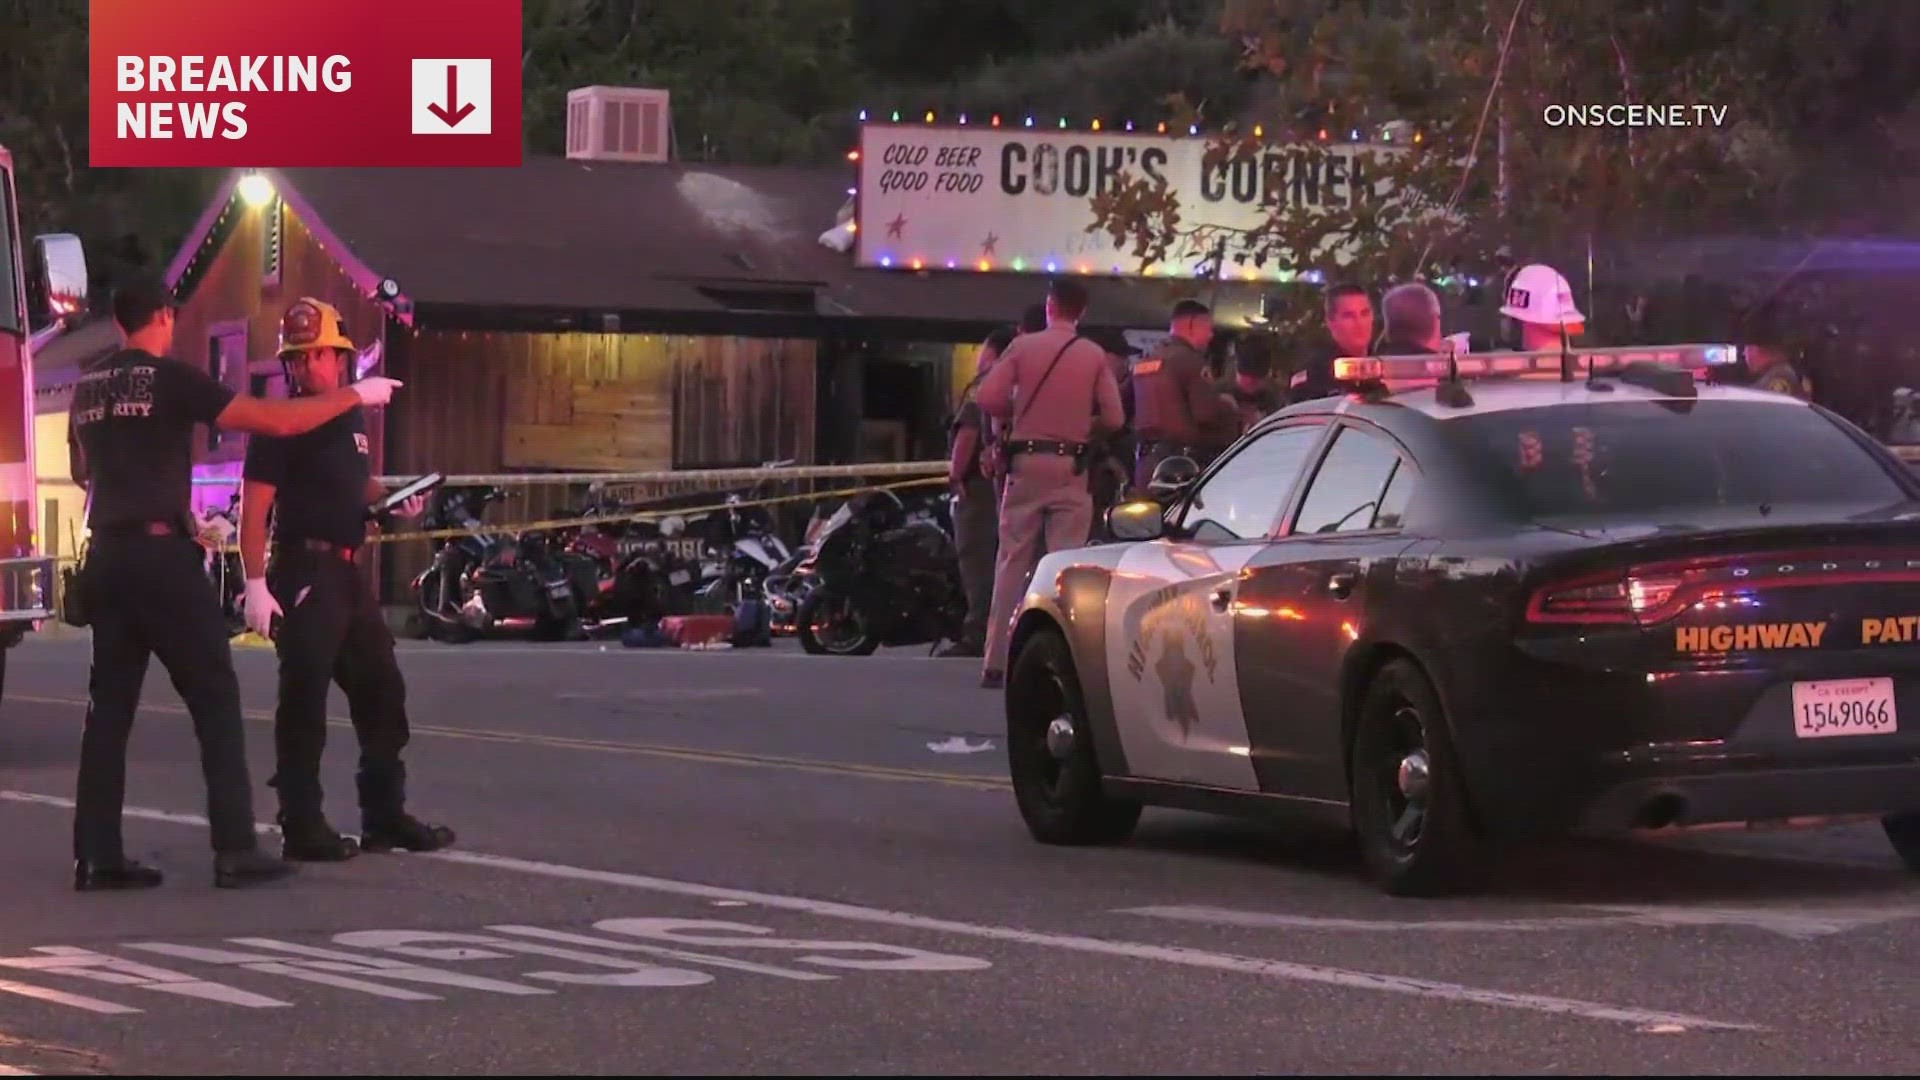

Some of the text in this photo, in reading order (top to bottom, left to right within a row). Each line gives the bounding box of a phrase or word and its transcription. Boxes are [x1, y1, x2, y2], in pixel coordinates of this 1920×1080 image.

[883, 143, 982, 168] COLD BEER
[879, 169, 984, 194] GOOD FOOD
[1675, 616, 1920, 652] HIGHWAY PAT
[1803, 699, 1889, 729] 1549066
